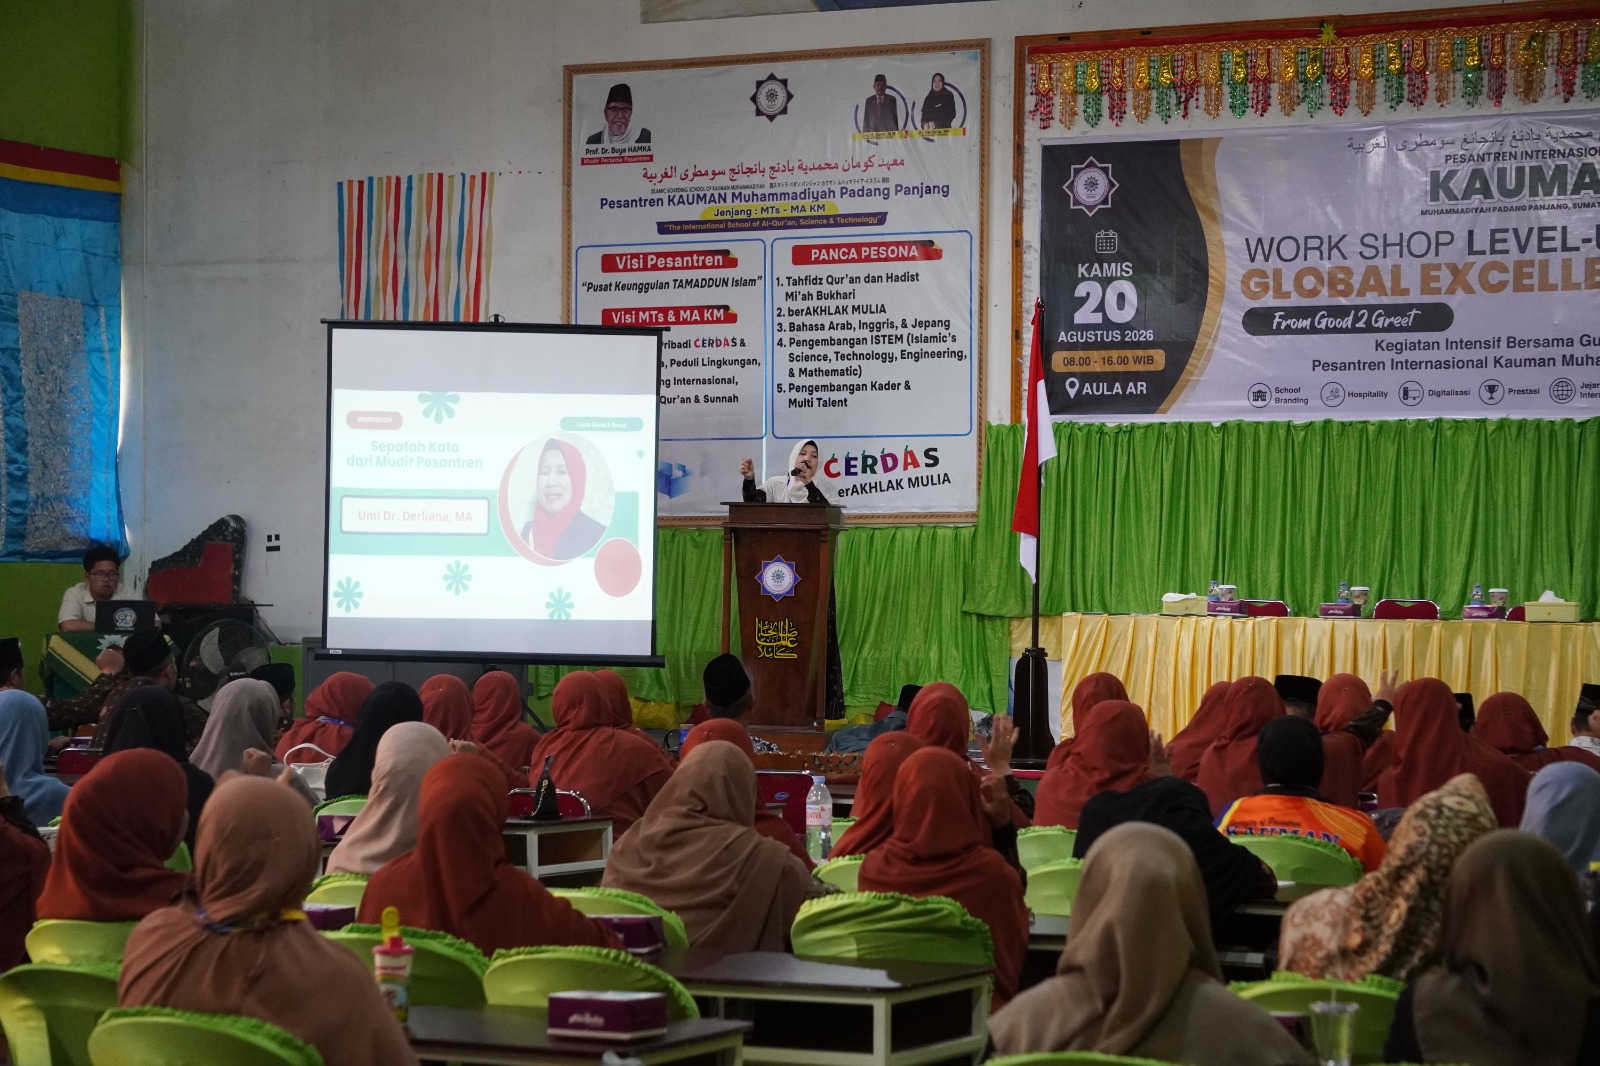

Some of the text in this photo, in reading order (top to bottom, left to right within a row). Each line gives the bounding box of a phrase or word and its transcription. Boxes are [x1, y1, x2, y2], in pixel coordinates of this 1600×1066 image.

[611, 147, 626, 155] Buya
[1445, 146, 1600, 164] PESANTREN INTERNASIO
[769, 159, 795, 179] بادنج
[798, 159, 839, 174] محمدية
[842, 154, 876, 172] كومان
[878, 158, 905, 171] معهد
[643, 166, 677, 185] الغربية
[729, 161, 766, 181] بانجانج
[1430, 162, 1600, 202] KAUMA
[600, 182, 950, 209] Pesantren KAUMAN Muhammadiyah Padang Panjang
[714, 204, 826, 218] Jenjang MTs MA KM
[1421, 206, 1491, 216] MUHAMMADIYAH
[1492, 204, 1527, 213] PADANG
[1528, 203, 1571, 212] PANJANG,
[682, 222, 726, 230] International
[800, 218, 827, 226] Science
[1245, 225, 1600, 263] WORK SHOP LEVEL-
[616, 252, 723, 269] Visi Pesantren
[811, 246, 918, 261] PANCA PESONA
[1078, 262, 1133, 278] KAMIS
[614, 279, 670, 293] Keunggulan
[672, 276, 729, 289] TAMADDUN
[776, 277, 783, 287] 1.
[786, 274, 823, 287] Tahfidz
[864, 273, 884, 285] dan
[886, 272, 920, 284] Hadist
[1241, 259, 1600, 300] GLOBAL EXCELLE
[816, 288, 856, 301] Bukhari
[1074, 279, 1137, 324] 20
[612, 308, 724, 324] Visi MTs & MA KM
[776, 304, 887, 318] 2. berAKHLAK MULIA
[776, 318, 950, 334] 3. Bahasa Arab, Inggris, & Jepang
[1272, 312, 1311, 331] From
[1316, 311, 1353, 329] Good
[1356, 310, 1368, 328] 2
[662, 336, 746, 349] ribadi CERDAS &
[776, 338, 786, 348] 4.
[788, 335, 868, 351] Pengembangan
[870, 334, 904, 346] ISTEM
[1058, 329, 1154, 343] AGUSTUS 2026
[1374, 334, 1600, 355] Kegiatan Intensif Bersama Gu
[670, 357, 699, 367] Peduli
[702, 358, 761, 369] Lingkungan,
[788, 348, 967, 365] Science, Technology, Engineering,
[1063, 354, 1154, 367] 08.00 16.00 WIB
[1313, 354, 1600, 371] Pesantren Internasional Kauman Muha
[788, 365, 863, 379] & Mathematic)
[674, 376, 738, 386] Internasional,
[776, 380, 911, 397] 5. Pengembangan Kader &
[1082, 381, 1147, 395] AULA AR
[1275, 386, 1301, 394] School
[1348, 390, 1388, 400] Hospitality
[1428, 388, 1471, 399] Digitalisasi
[1508, 388, 1540, 396] Prestasi
[694, 394, 700, 404] &
[704, 394, 739, 403] Sunnah
[788, 396, 848, 409] Multi Talent
[1275, 397, 1309, 405] Branding
[357, 416, 393, 424] WORKSHOP
[371, 440, 460, 456] Sepatah Kata
[346, 454, 483, 469] dari Mudir Pesantren
[824, 445, 940, 479] CERDAS
[838, 472, 952, 498] erAKHLAK MULIA
[358, 510, 472, 523] Umi Dr. Derliana, MA
